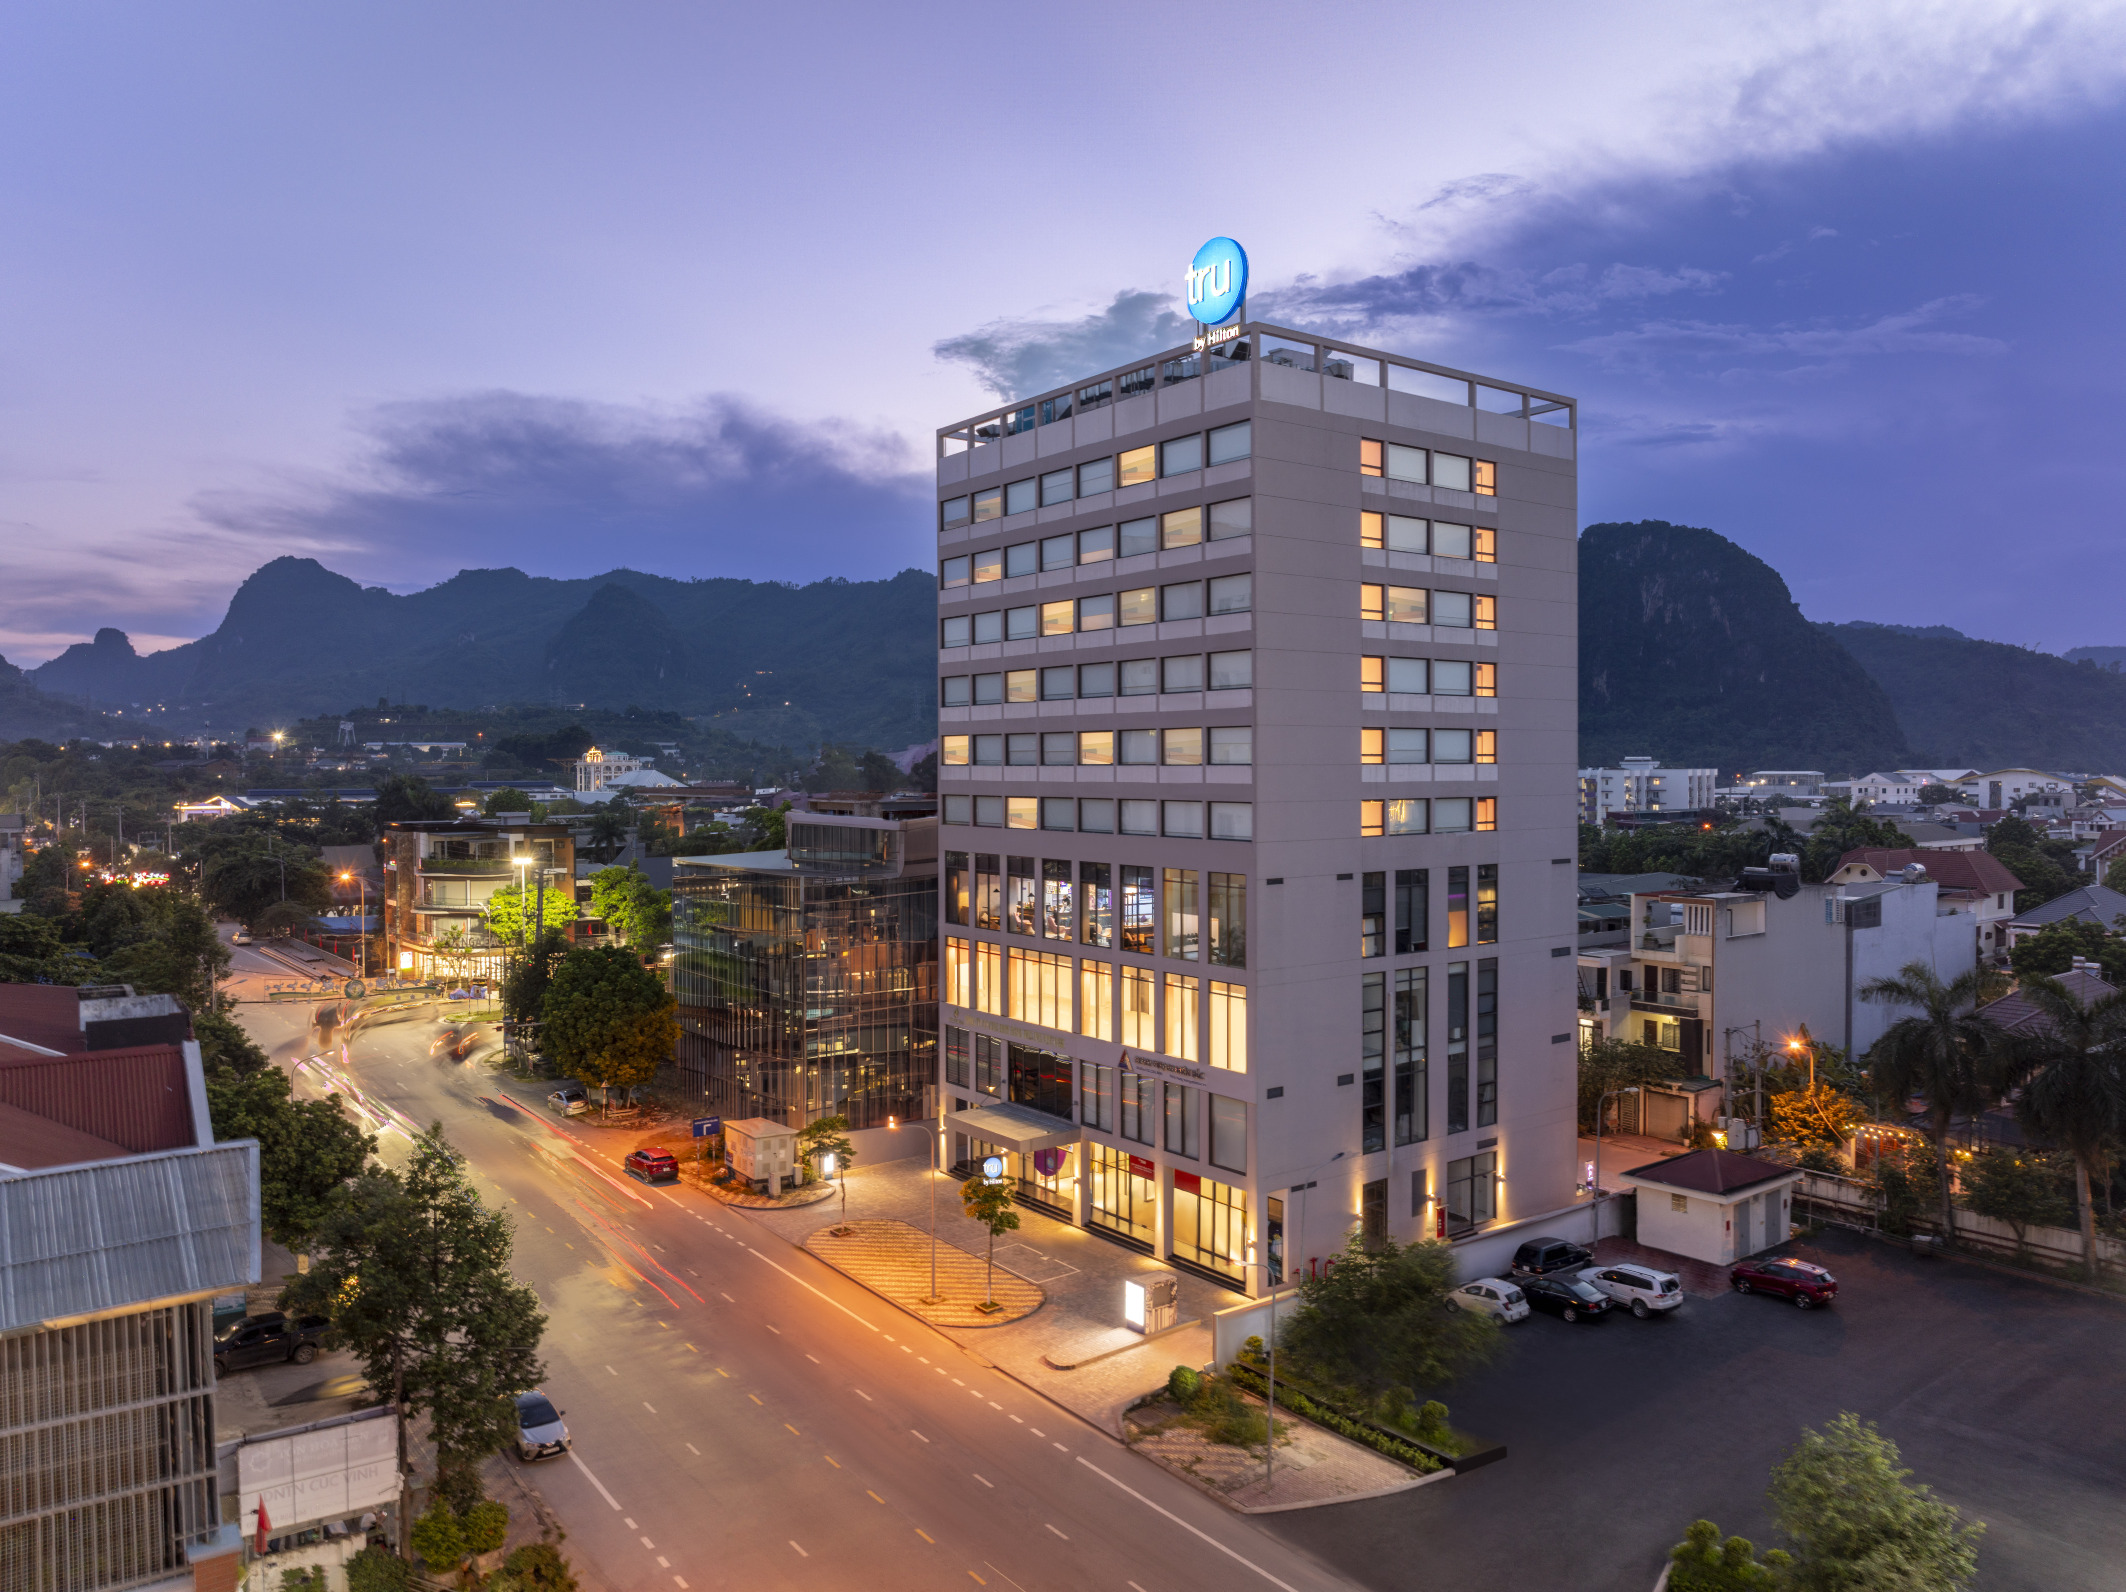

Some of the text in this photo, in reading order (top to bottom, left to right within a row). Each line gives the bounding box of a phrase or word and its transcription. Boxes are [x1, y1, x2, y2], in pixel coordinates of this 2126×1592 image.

[1184, 259, 1231, 305] tru
[1192, 325, 1239, 352] by Hilton
[982, 1162, 998, 1173] tru
[263, 1482, 305, 1502] DNTN
[343, 1466, 378, 1482] VINH
